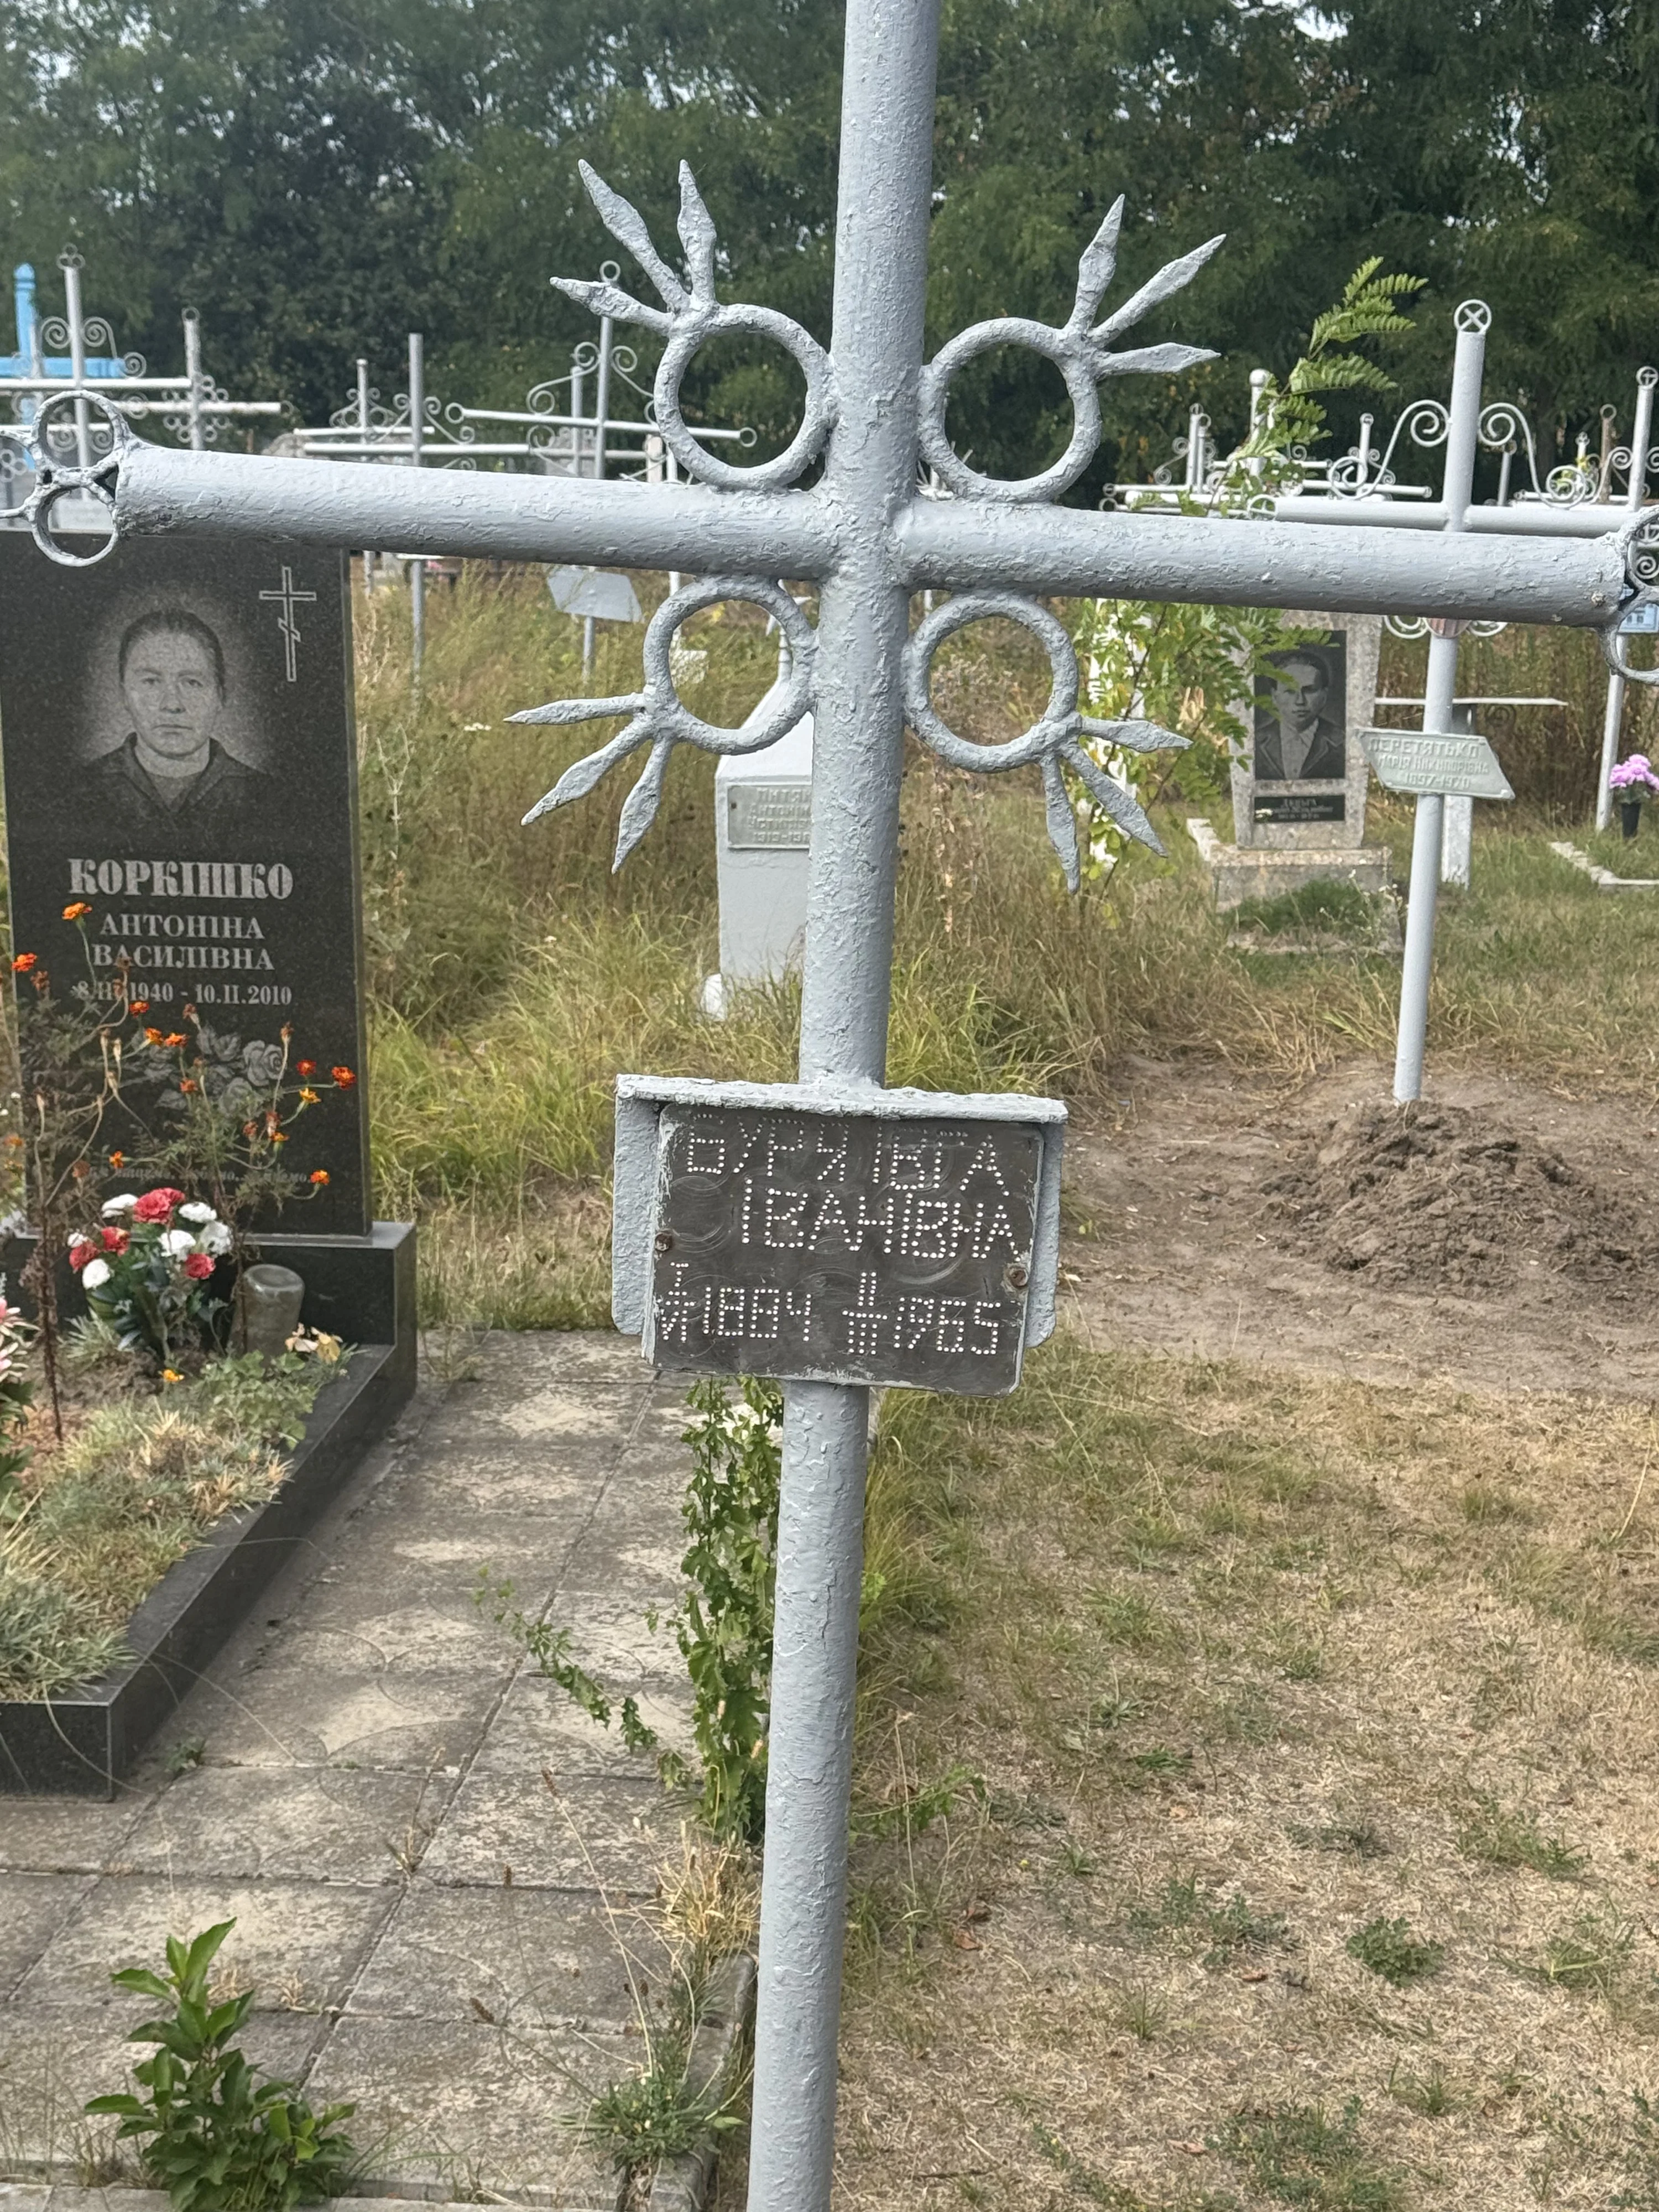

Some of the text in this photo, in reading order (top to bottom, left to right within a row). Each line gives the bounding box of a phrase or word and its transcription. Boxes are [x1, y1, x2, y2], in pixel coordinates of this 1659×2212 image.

[1367, 738, 1480, 758] ПЕРЕТЯТЬКО
[67, 858, 294, 900] КОРКІШКО
[100, 914, 265, 940] АНТОНІНА
[91, 943, 275, 971] ВАСИЛІВНА
[742, 1177, 1022, 1262] ІВАНІВНА
[703, 1286, 1001, 1357] 1884 1965
